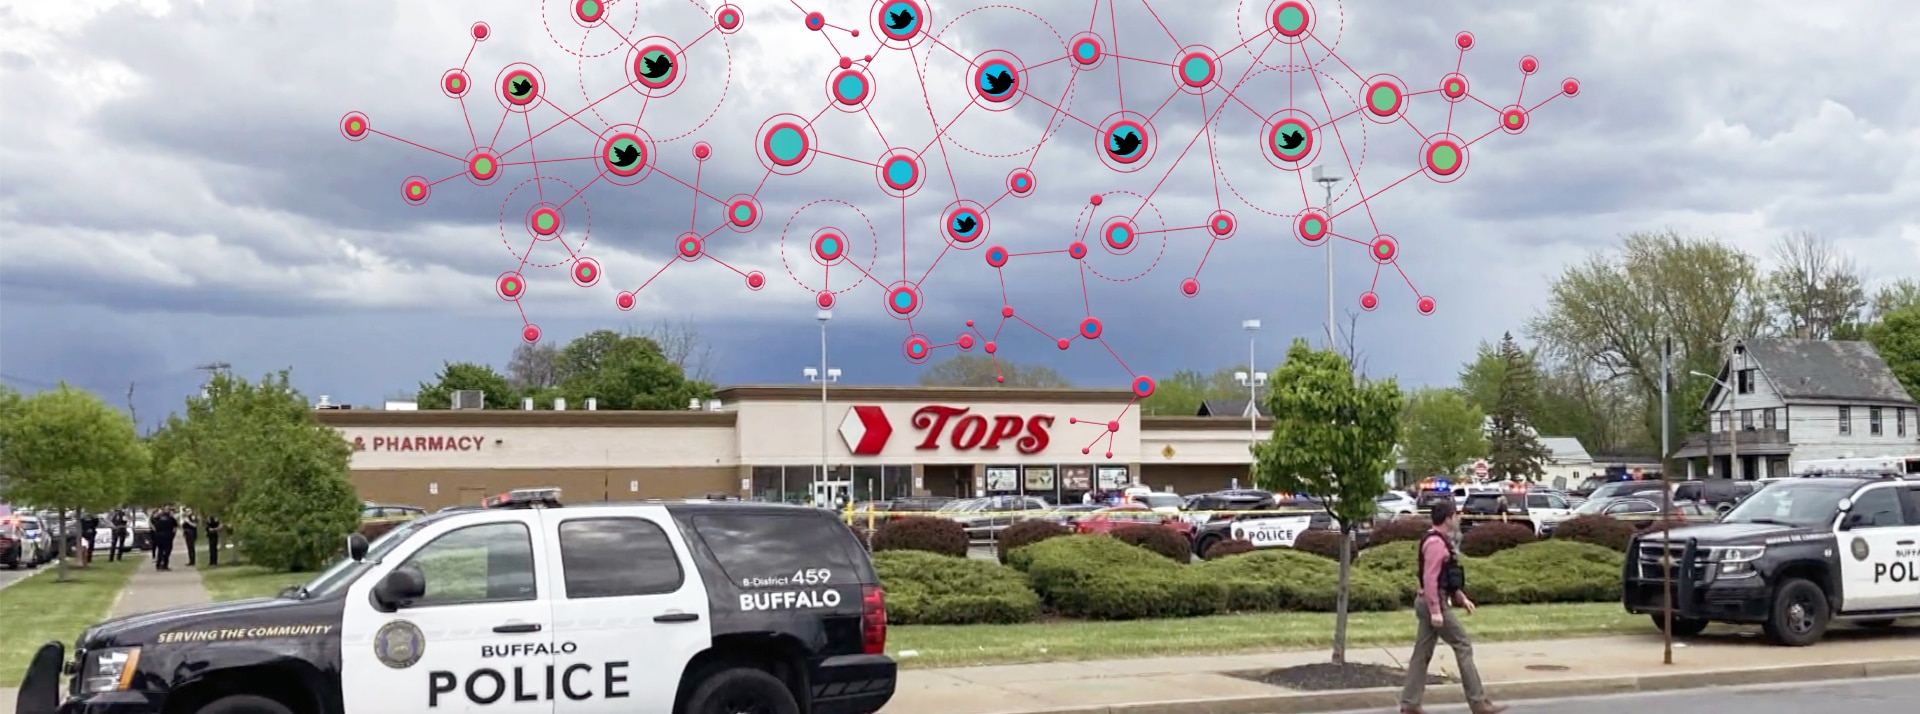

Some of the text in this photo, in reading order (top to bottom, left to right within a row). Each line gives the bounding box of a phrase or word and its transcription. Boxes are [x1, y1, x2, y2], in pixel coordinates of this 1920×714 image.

[373, 436, 484, 451] PHARMACY
[1248, 530, 1294, 541] POLICE
[743, 568, 831, 586] B-District 459
[740, 589, 841, 611] BUFFALO
[157, 625, 332, 643] SERVING THE COMMUNITY
[481, 641, 578, 658] BUFFALO
[428, 661, 630, 708] POLICE
